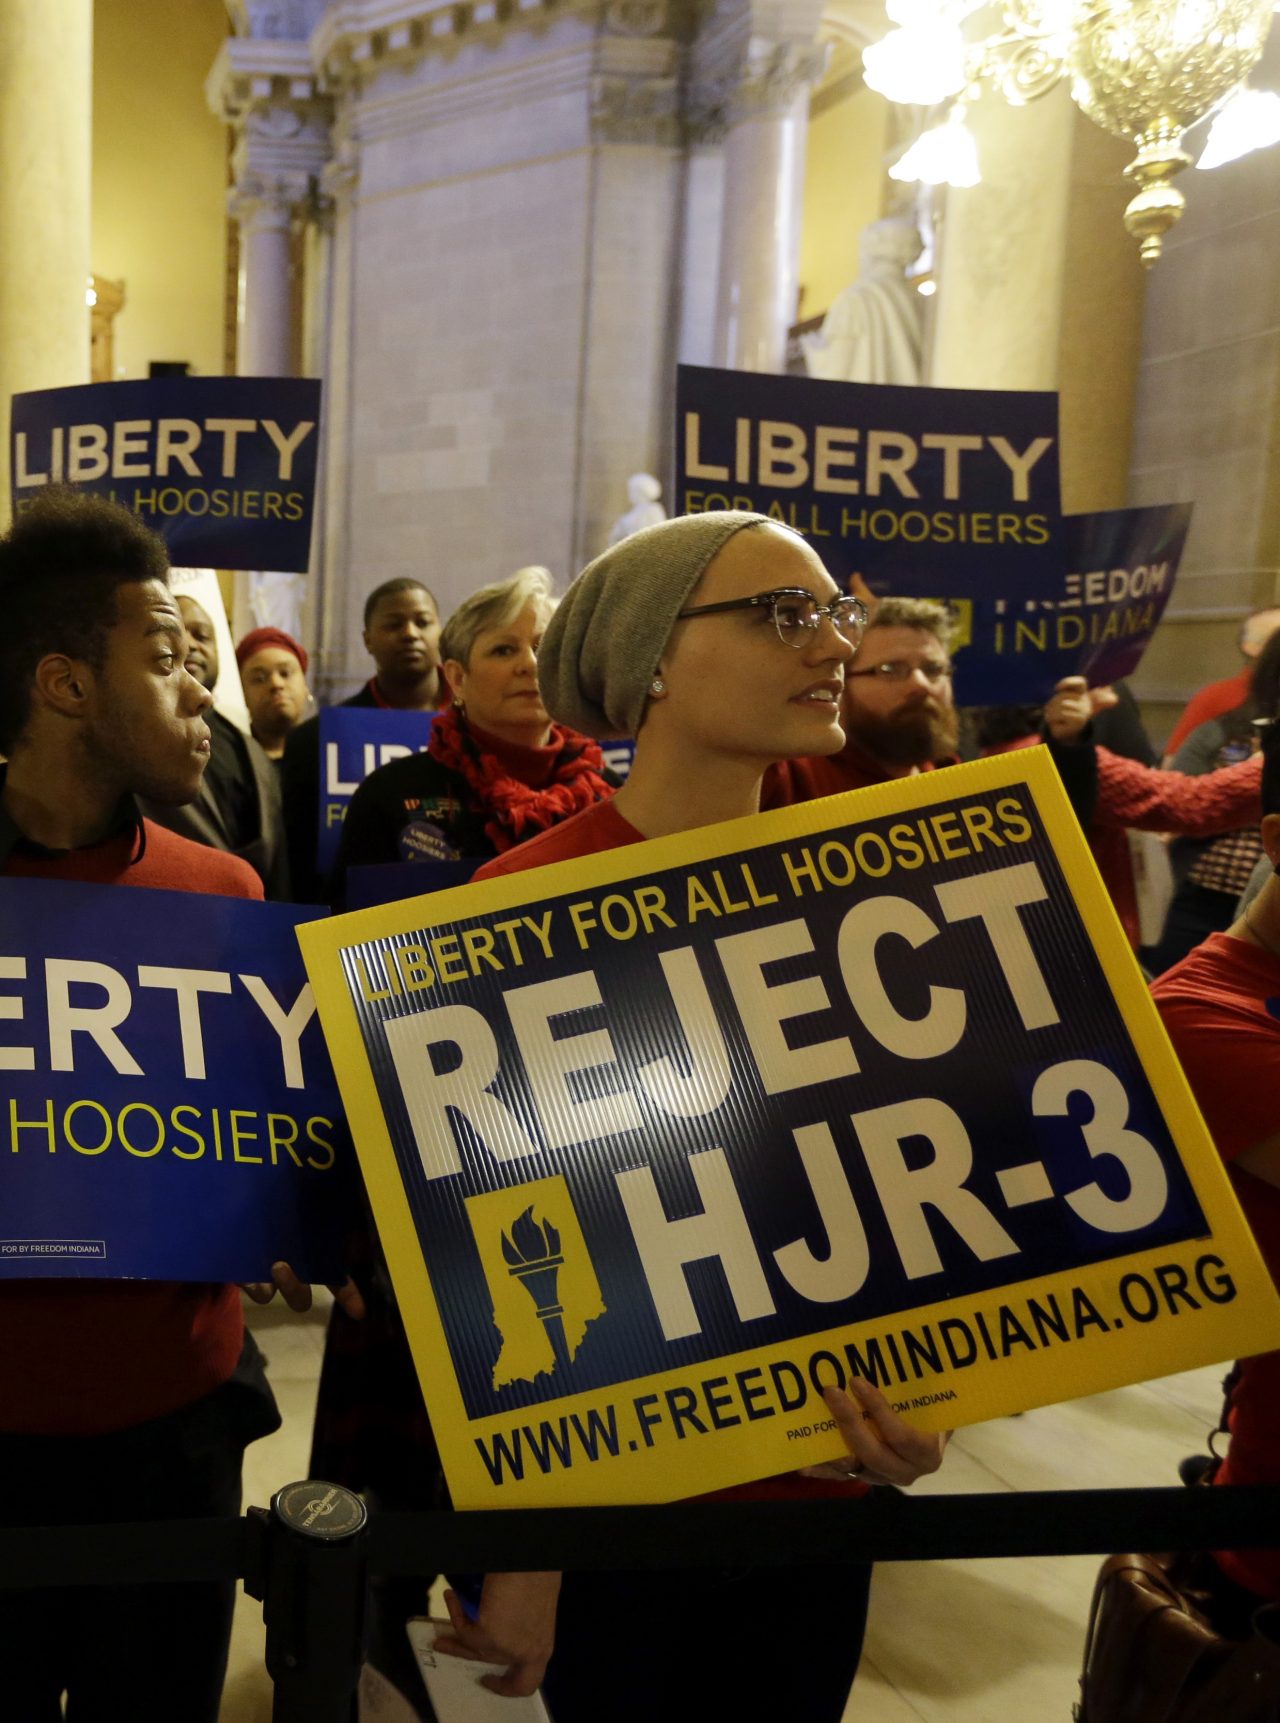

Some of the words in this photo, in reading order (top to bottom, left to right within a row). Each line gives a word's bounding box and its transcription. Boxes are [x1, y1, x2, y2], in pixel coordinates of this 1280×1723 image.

[15, 418, 315, 488] LIBERTY
[684, 412, 1053, 502] LIBERTY
[134, 488, 304, 521] HOOSIERS
[768, 500, 832, 537] ALL
[841, 508, 1050, 545] HOOSIERS
[994, 602, 1156, 655] INDIANA
[354, 911, 561, 1003] LIBERTY
[569, 884, 677, 950] FOR
[685, 861, 779, 926] ALL
[782, 798, 1033, 897] HOOSIERS
[382, 861, 1062, 1182] REJECT
[9, 1098, 335, 1170] HOOSIERS
[613, 1057, 1170, 1343] HJR-3
[1, 1245, 18, 1253] FOR
[19, 1245, 29, 1253] BY
[30, 1244, 67, 1253] FREEDOM
[68, 1245, 100, 1253] INDIANA
[474, 1253, 1238, 1487] WWW.FREEDOMINDIANA.ORG
[912, 1390, 958, 1409] INDIANA
[786, 1426, 812, 1440] PAID
[814, 1419, 838, 1433] FOR
